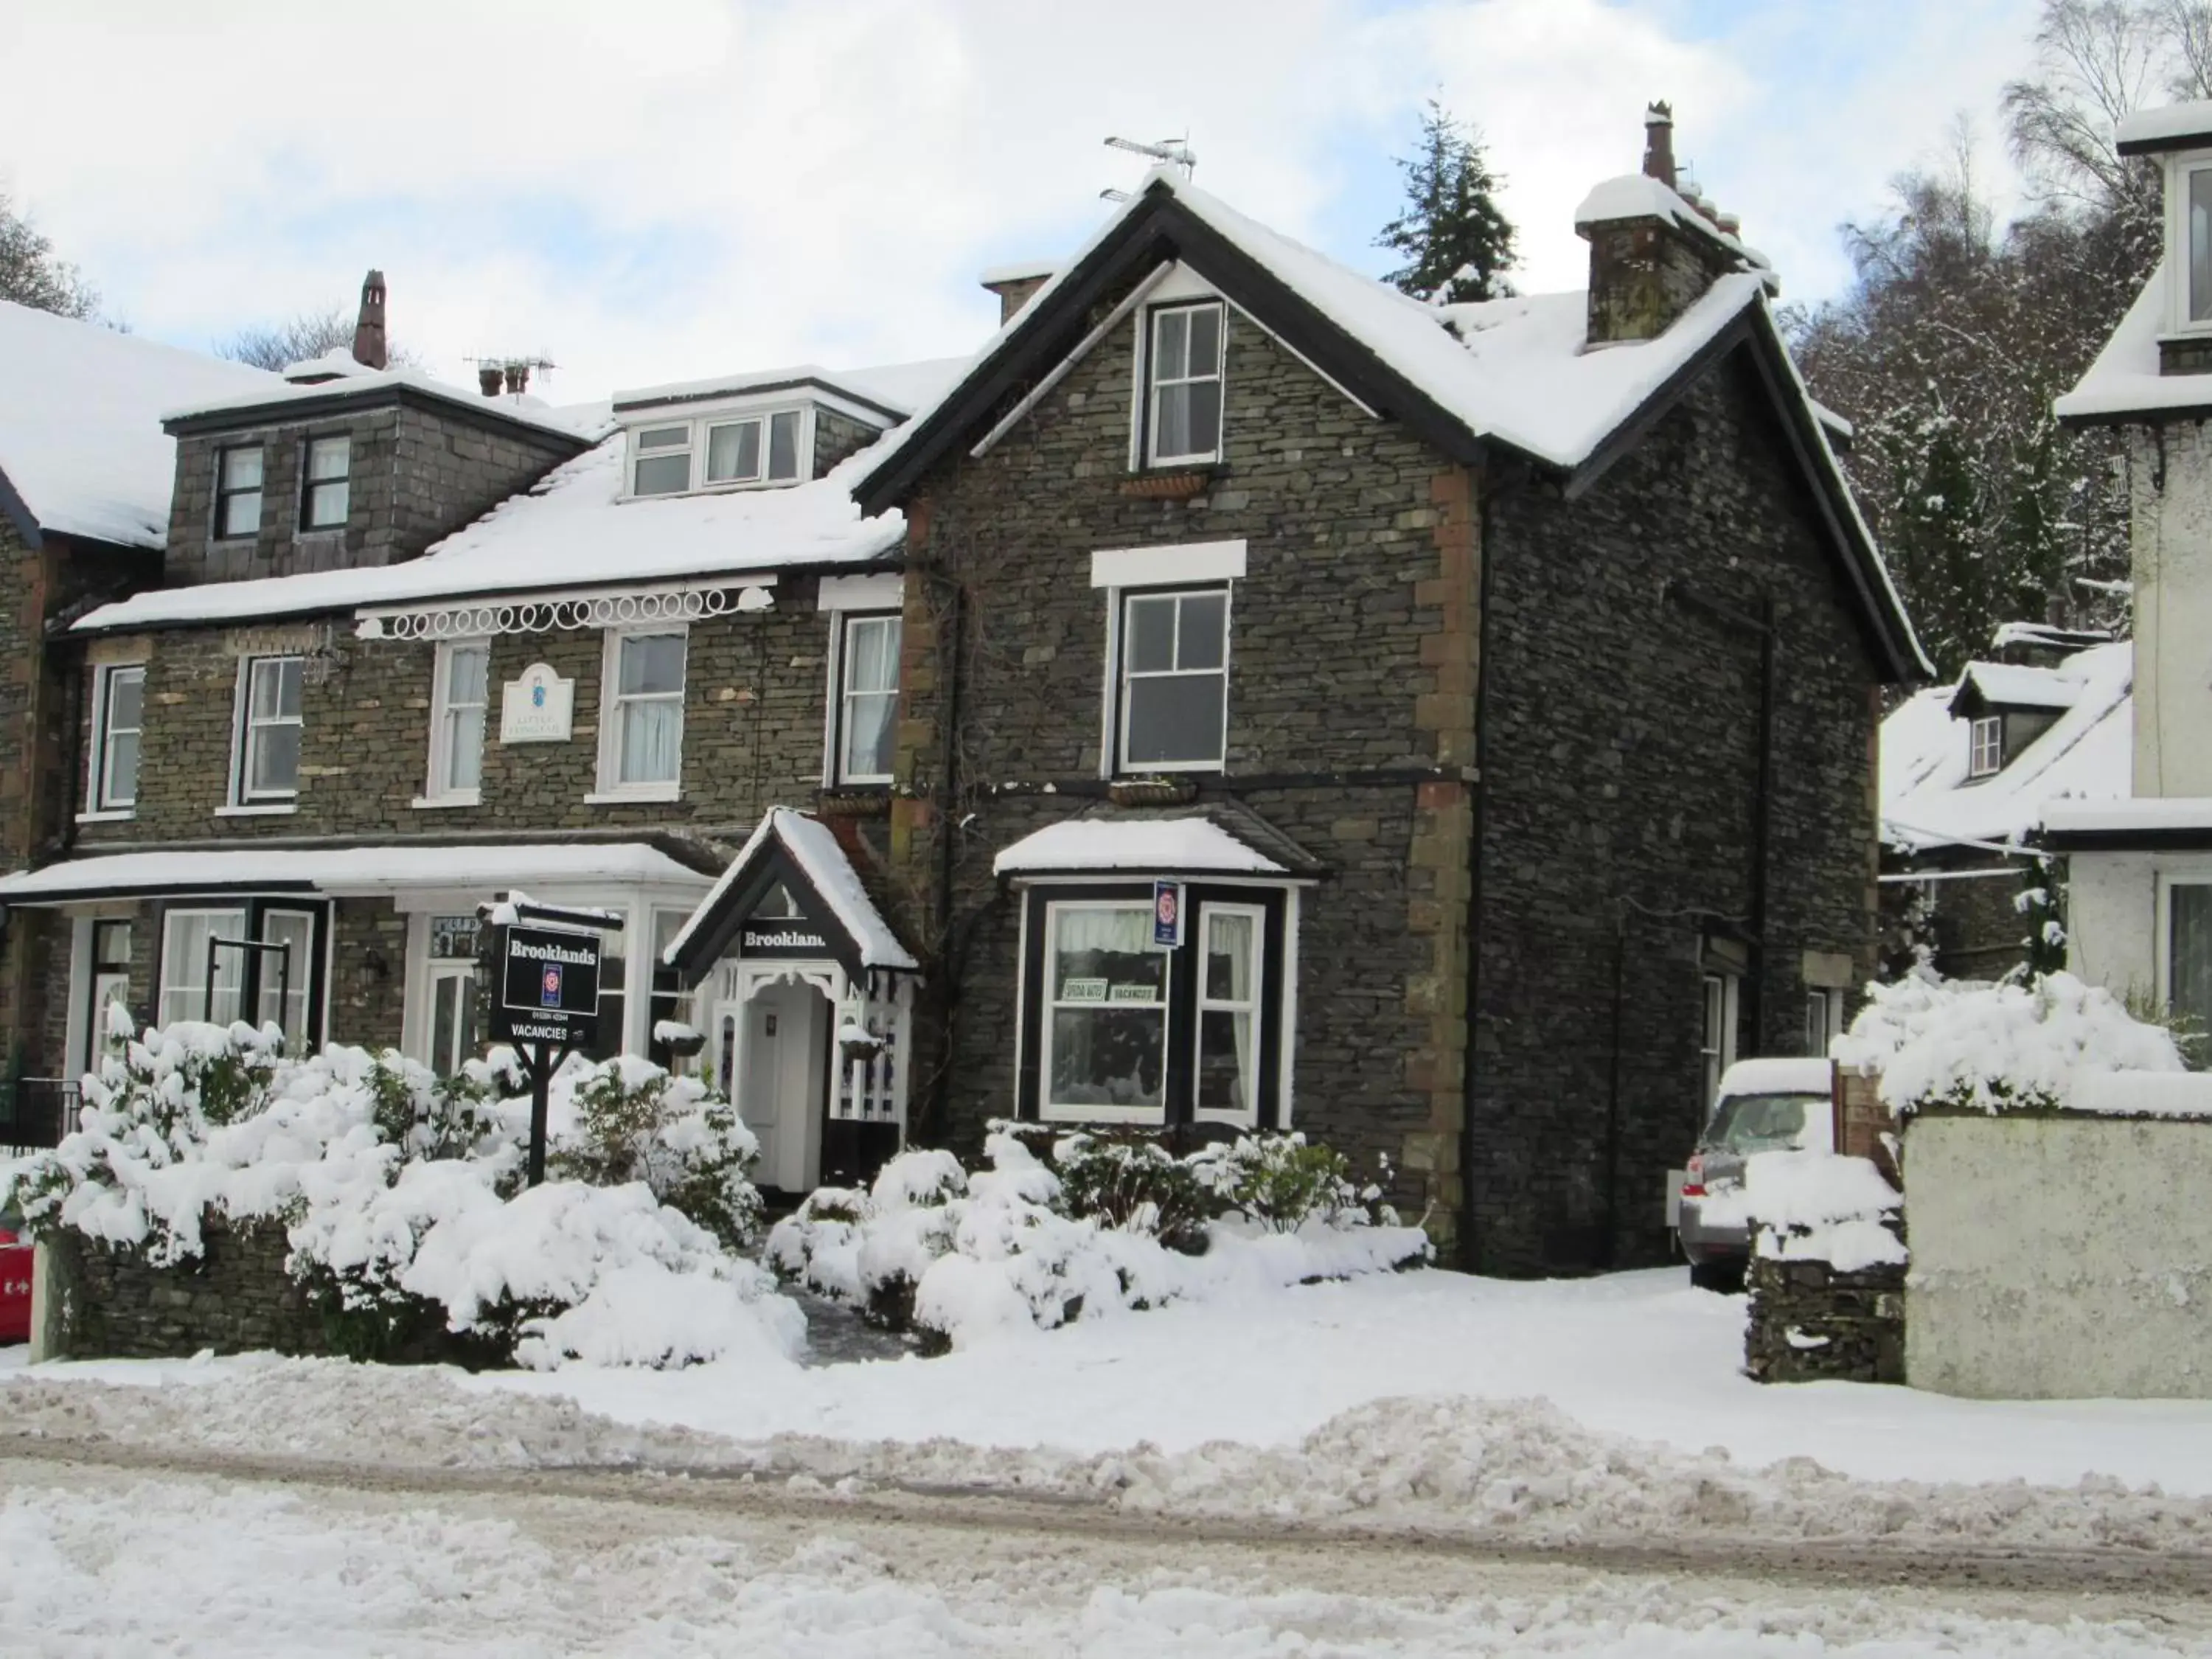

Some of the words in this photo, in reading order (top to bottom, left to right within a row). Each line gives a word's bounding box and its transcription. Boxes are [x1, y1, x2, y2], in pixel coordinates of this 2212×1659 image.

[744, 931, 826, 947] Brooklan
[510, 940, 596, 966] Brooklands
[511, 1023, 567, 1040] VACANCIES
